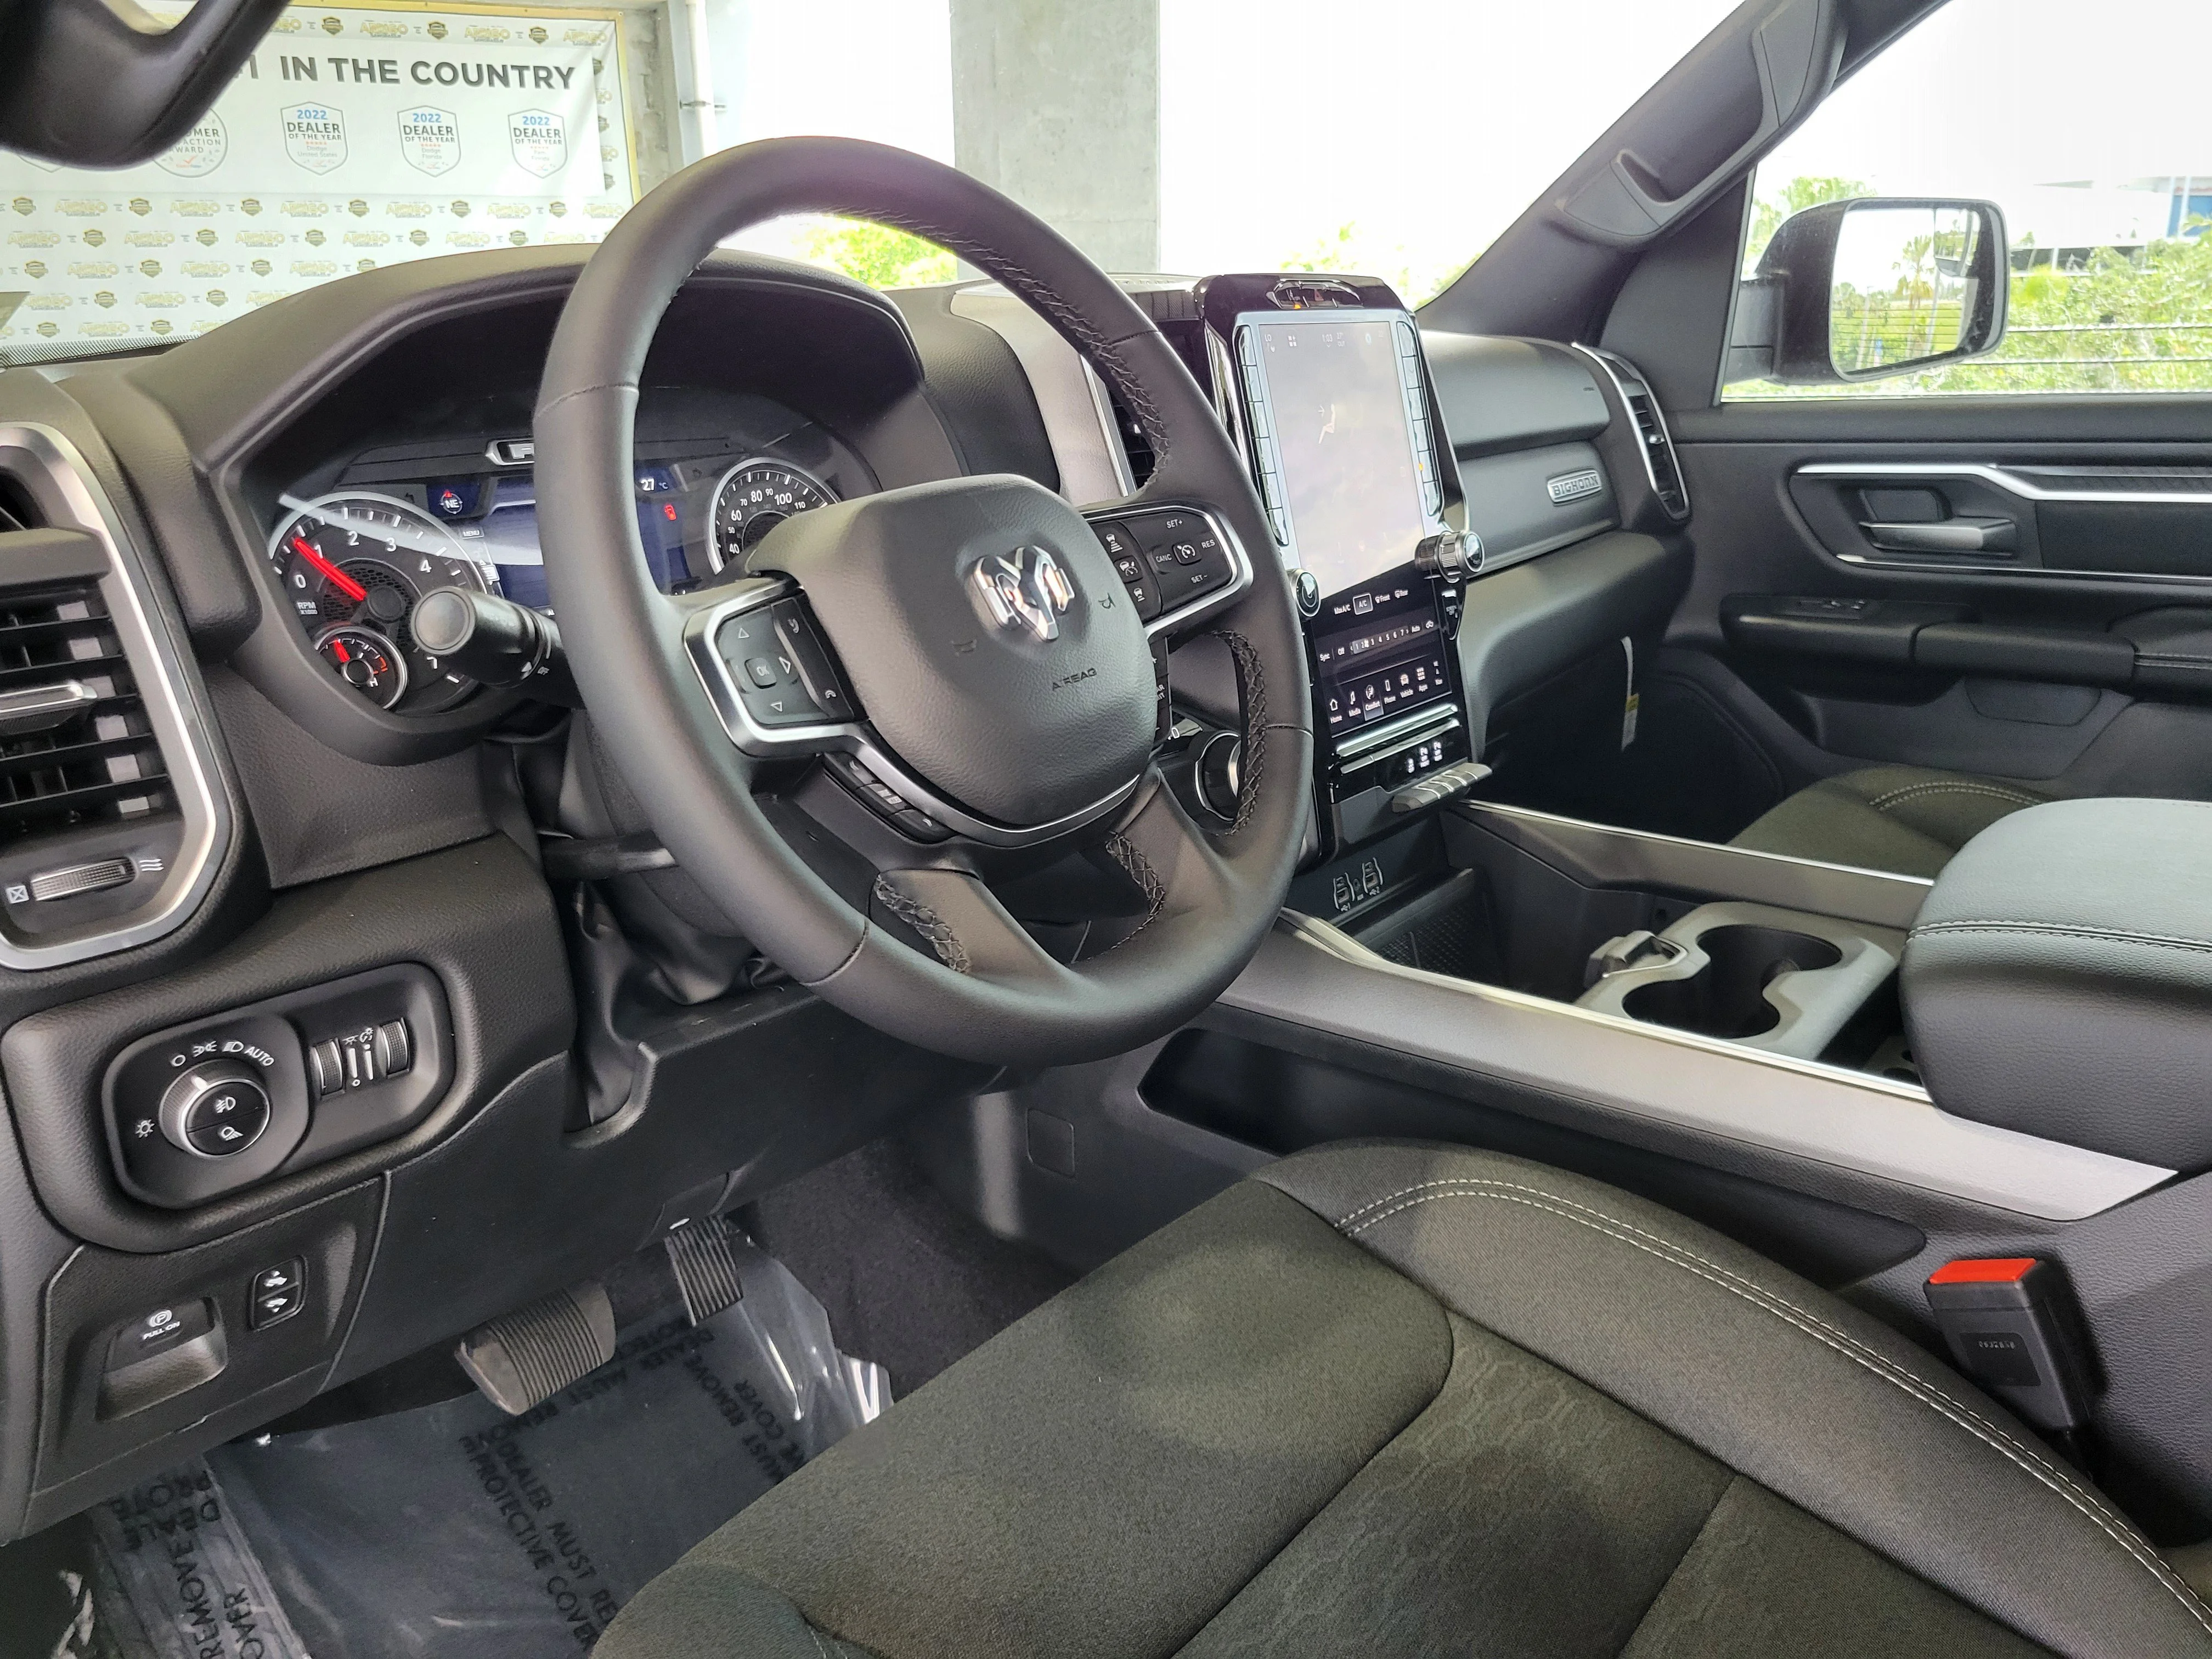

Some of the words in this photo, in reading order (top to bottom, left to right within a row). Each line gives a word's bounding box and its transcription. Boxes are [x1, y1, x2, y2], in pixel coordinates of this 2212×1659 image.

[280, 56, 318, 81] IN
[328, 58, 400, 84] THE
[411, 60, 575, 90] COUNTRY
[297, 109, 328, 120] 2022
[413, 113, 442, 123] 2022
[522, 116, 550, 126] 2022
[287, 122, 341, 133] DEALER
[403, 125, 454, 137] DEALER
[514, 127, 561, 138] DEALER
[641, 478, 654, 491] 27
[751, 489, 763, 503] 80
[765, 488, 773, 496] 90
[445, 500, 460, 508] NE
[774, 492, 792, 506] 100
[794, 501, 806, 509] 110
[731, 509, 742, 521] 60
[1166, 519, 1183, 529] SET+
[348, 531, 359, 546] 2
[386, 537, 396, 552] 3
[1201, 539, 1215, 549] RES
[314, 544, 323, 558] 1
[729, 543, 740, 554] 40
[1155, 554, 1172, 563] CANC
[420, 559, 432, 573] 4
[295, 574, 306, 588] 0
[1358, 600, 1367, 608] A/C
[244, 1045, 274, 1067] AUTO
[143, 1327, 165, 1341] PULL
[165, 1321, 180, 1330] ON
[223, 1587, 266, 1659] OVER
